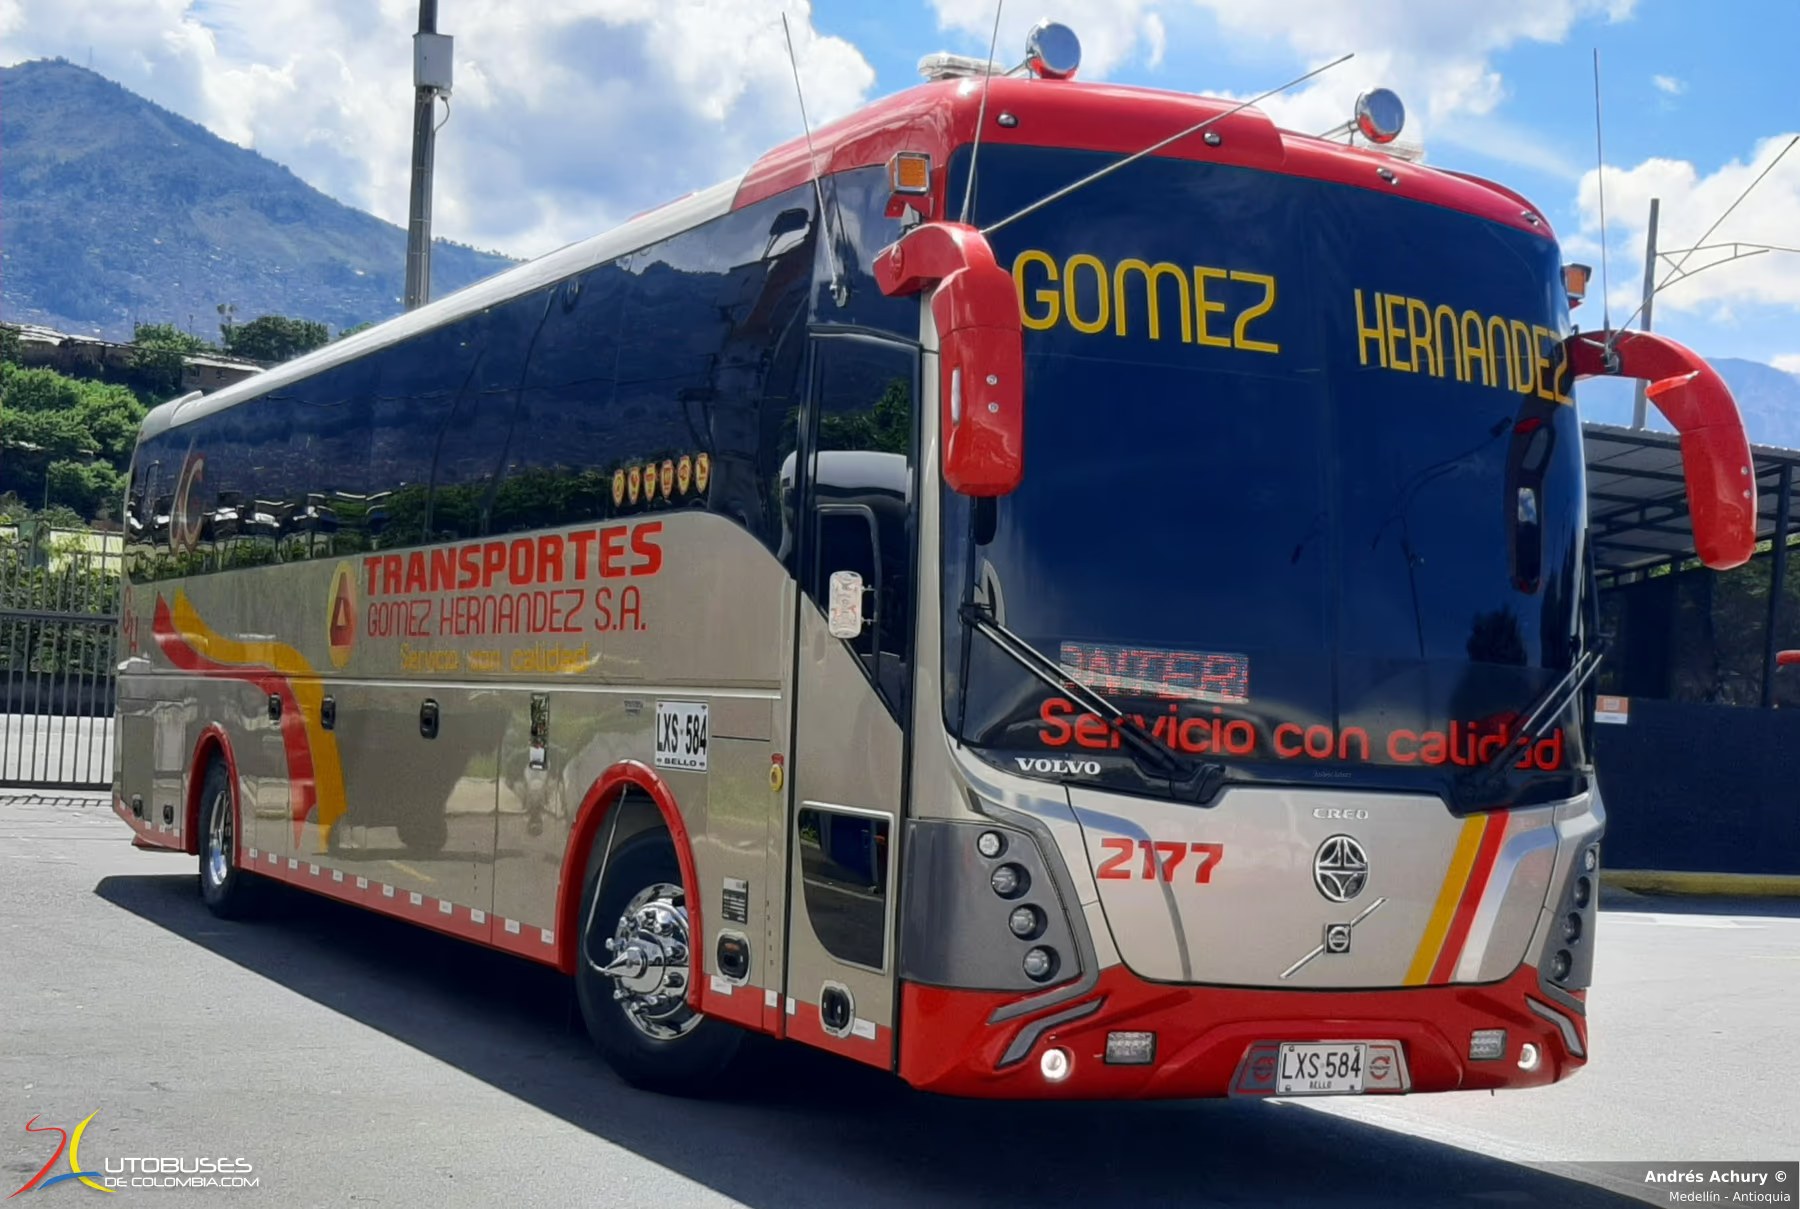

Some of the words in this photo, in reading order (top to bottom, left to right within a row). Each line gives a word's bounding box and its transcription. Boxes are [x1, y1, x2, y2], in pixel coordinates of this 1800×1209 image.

[1012, 250, 1279, 354] GOMEZ
[1354, 288, 1573, 407] HERNANDEZ
[363, 521, 663, 596] TRANSPORTES
[367, 600, 433, 637] GOMEZ
[439, 588, 585, 636] HERNANDEZ
[594, 585, 647, 632] S.A.
[657, 712, 678, 753] LXS
[685, 714, 707, 755] 584
[1272, 722, 1370, 760] con
[664, 758, 697, 767] BELLO
[1014, 757, 1101, 775] VOLVO
[1312, 808, 1369, 820] CREO
[1096, 838, 1224, 884] 2177
[1282, 1052, 1320, 1080] LXS
[1325, 1052, 1361, 1079] 584
[1309, 1081, 1332, 1090] BELLO
